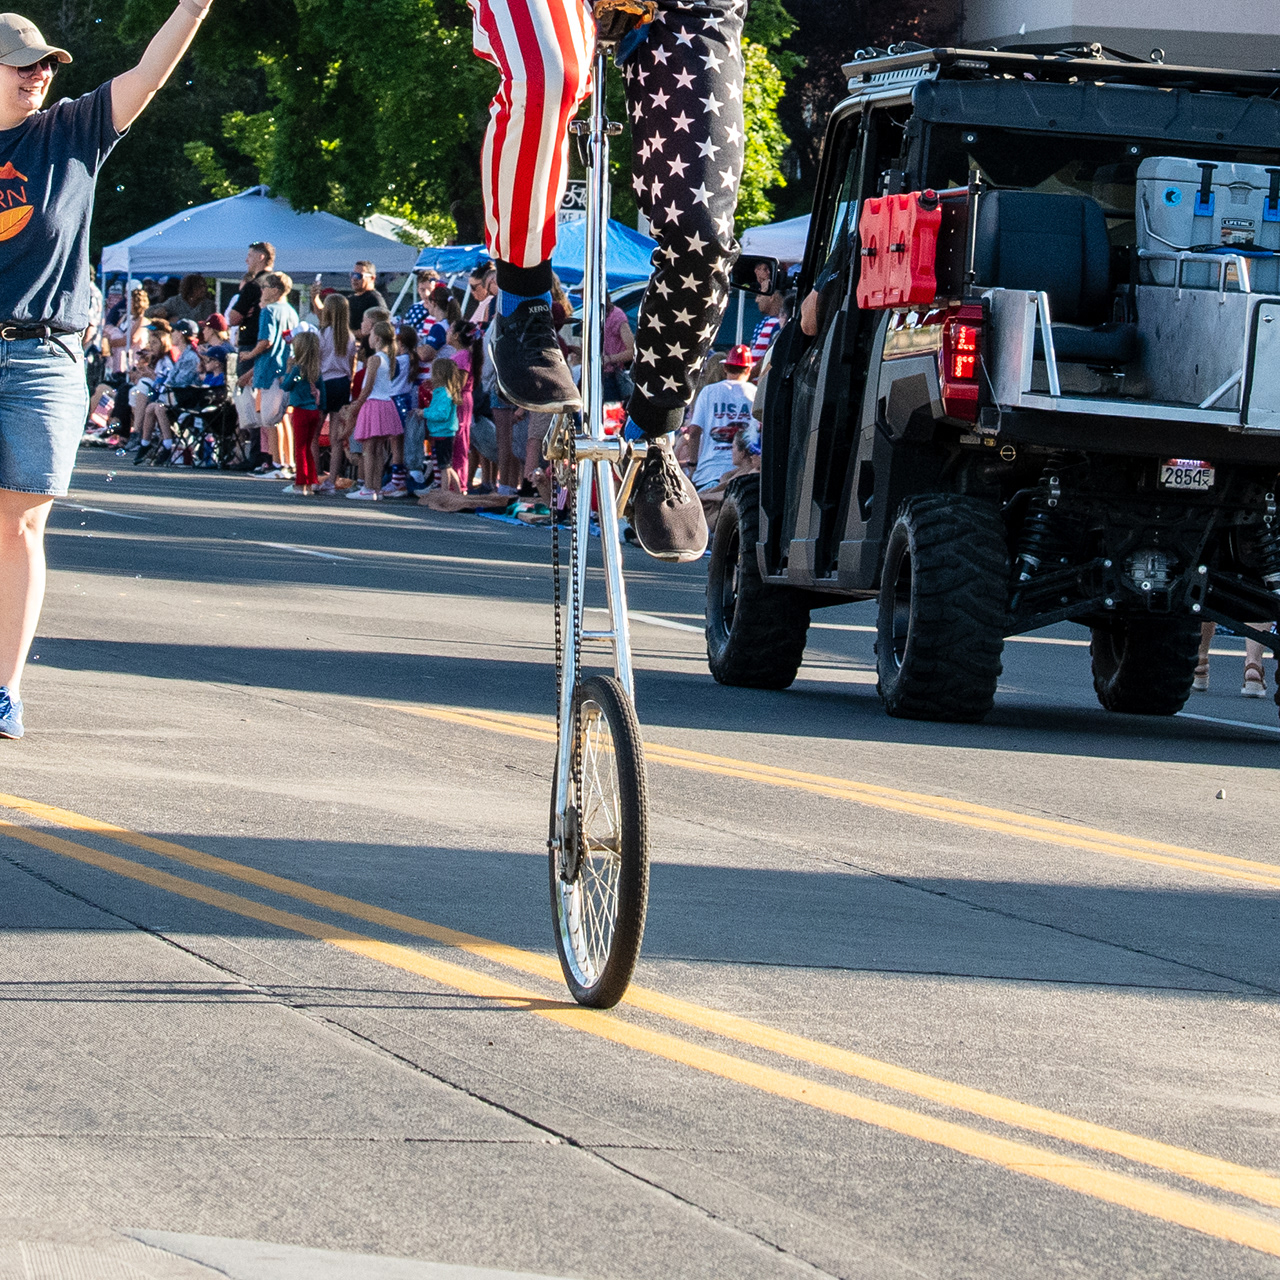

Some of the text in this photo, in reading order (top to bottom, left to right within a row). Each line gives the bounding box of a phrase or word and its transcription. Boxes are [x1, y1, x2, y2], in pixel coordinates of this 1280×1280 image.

[528, 304, 549, 314] XERO
[713, 402, 751, 420] USA
[1165, 467, 1202, 486] 2854
